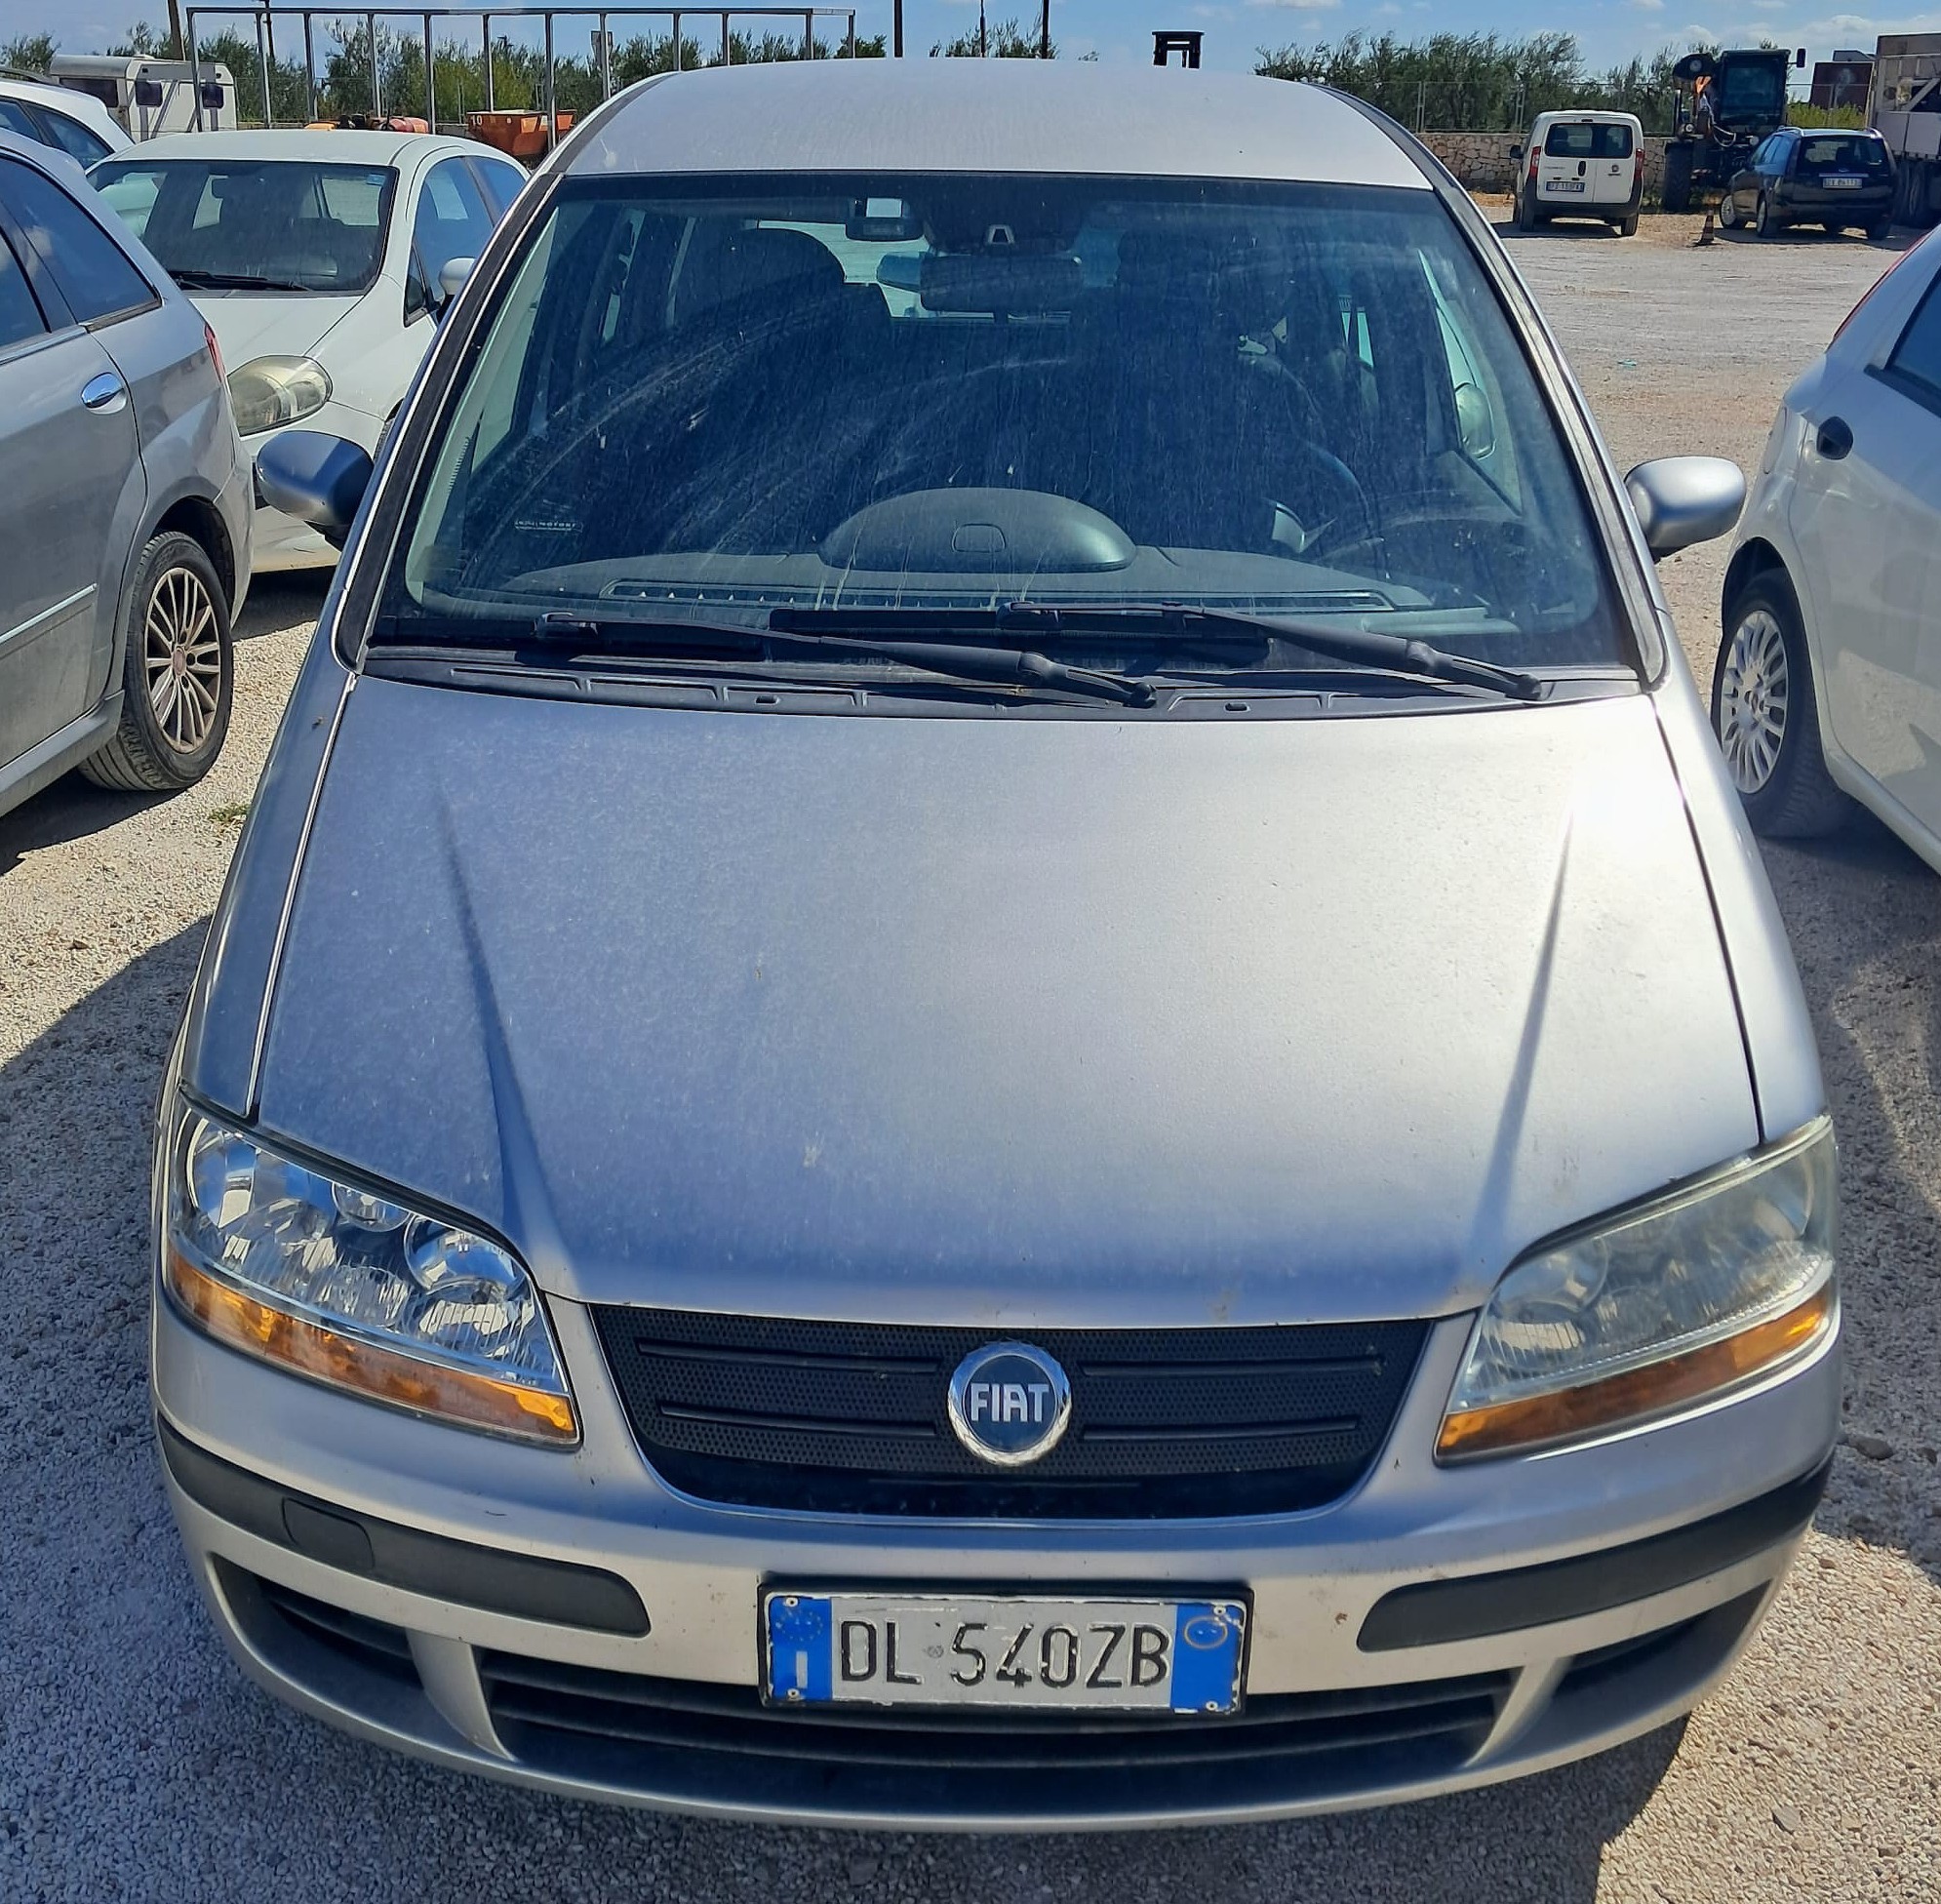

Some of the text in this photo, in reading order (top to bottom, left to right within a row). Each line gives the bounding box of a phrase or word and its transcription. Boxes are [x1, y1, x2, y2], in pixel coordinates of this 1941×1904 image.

[970, 1382, 1050, 1423] FIAT
[840, 1619, 922, 1686] DL
[950, 1621, 1172, 1689] 540ZB
